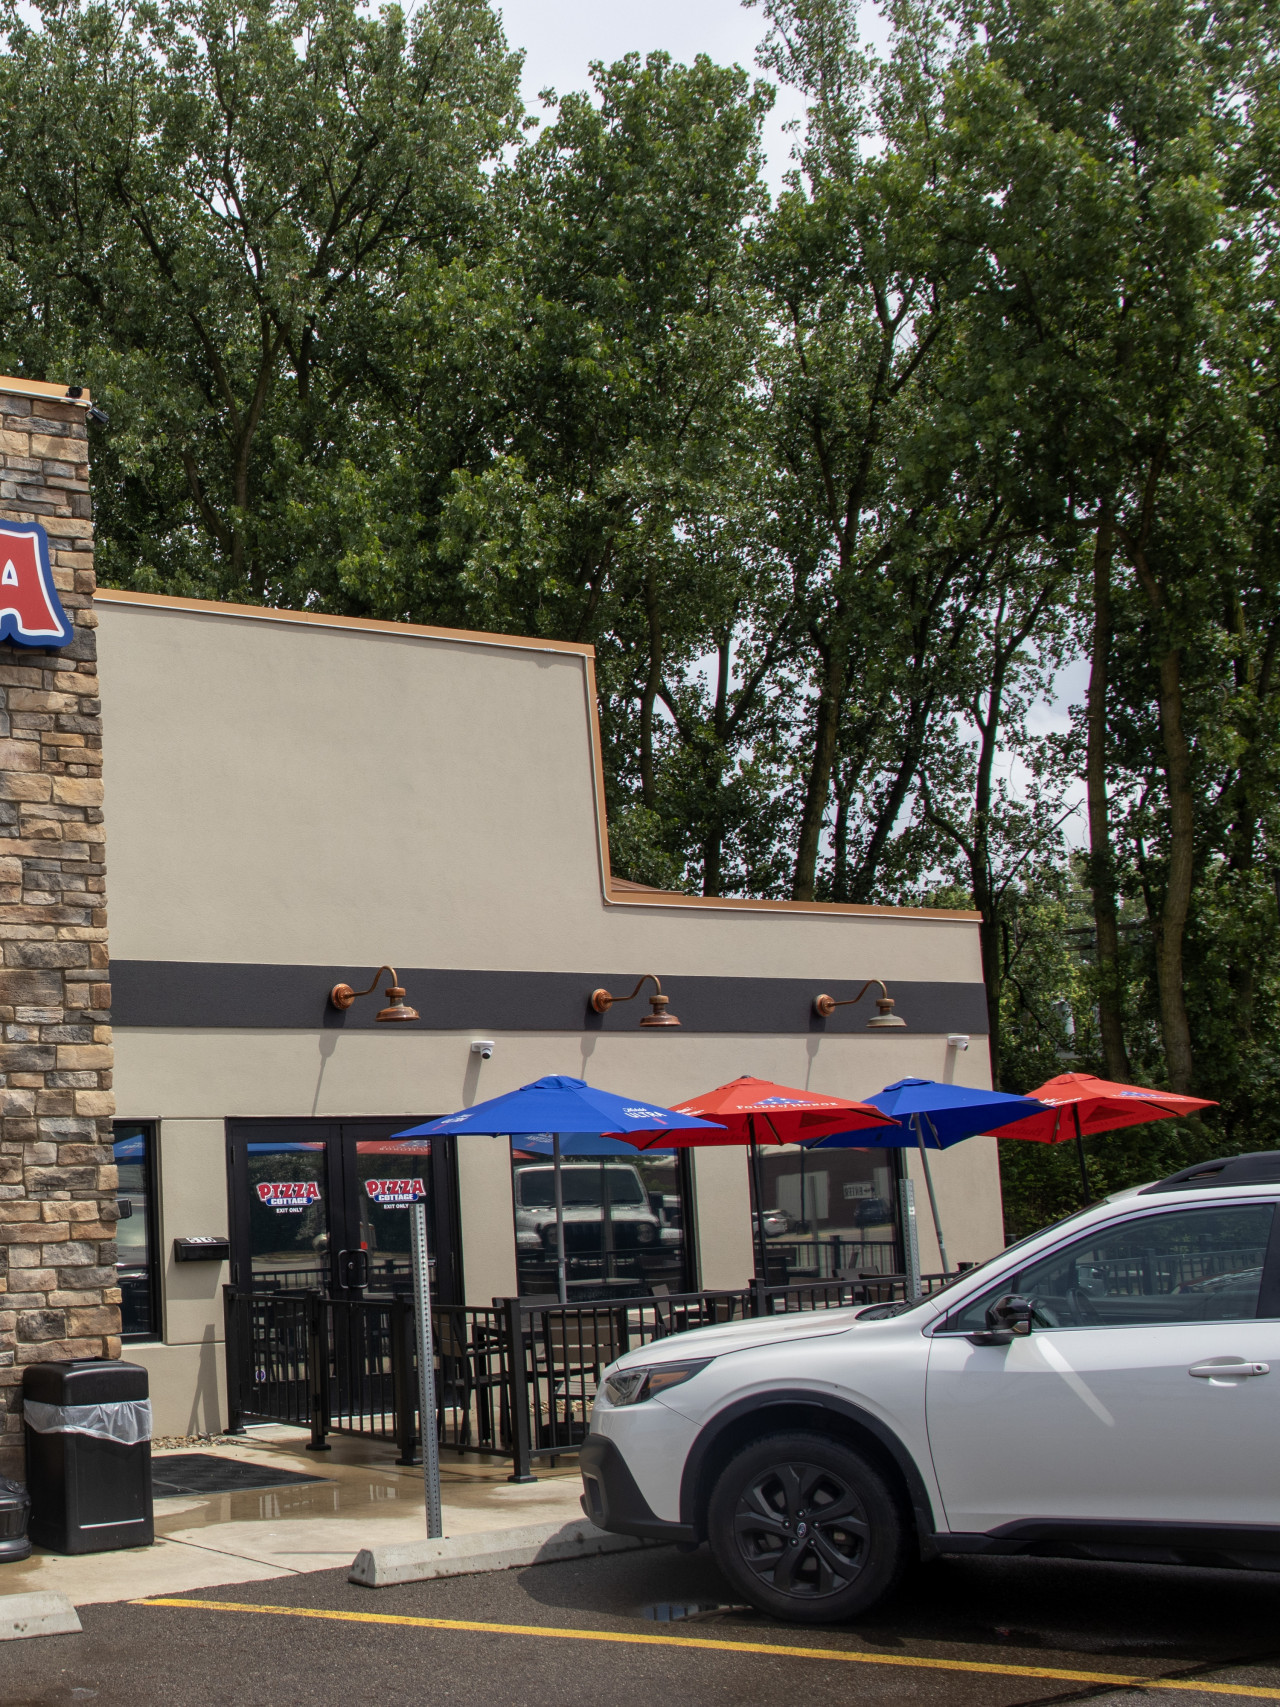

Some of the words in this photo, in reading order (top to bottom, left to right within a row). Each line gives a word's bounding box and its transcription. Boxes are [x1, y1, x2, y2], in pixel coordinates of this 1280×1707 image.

[257, 1182, 321, 1201] PIZZA
[366, 1179, 426, 1197] PIZZA
[271, 1197, 308, 1205] COTTAGE
